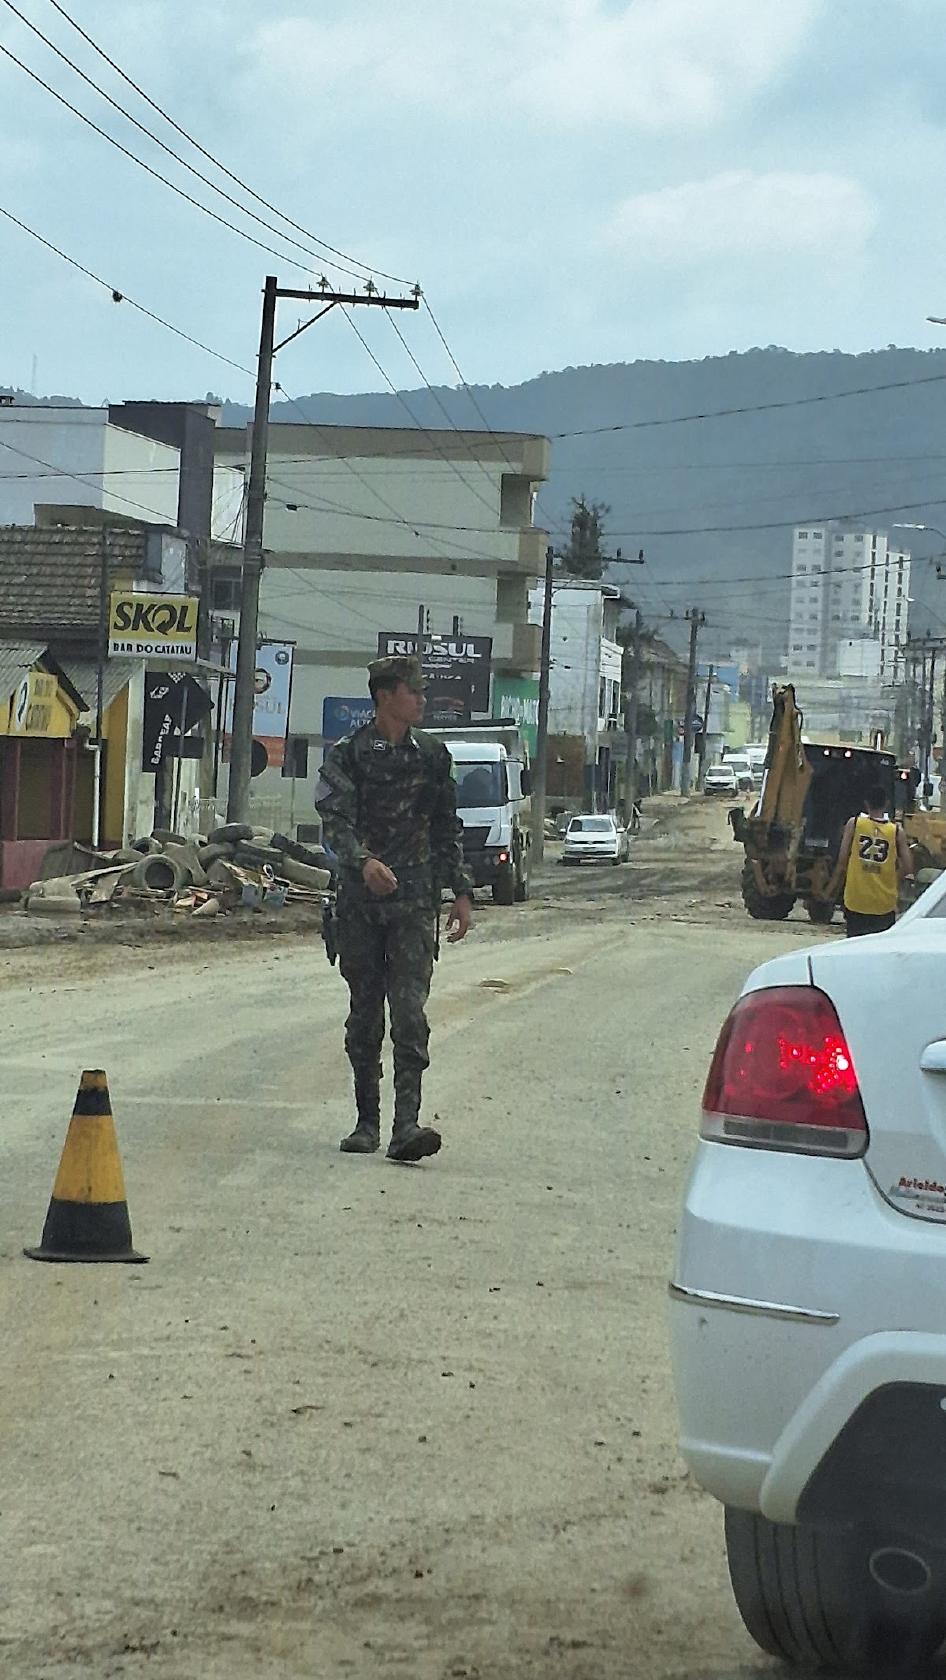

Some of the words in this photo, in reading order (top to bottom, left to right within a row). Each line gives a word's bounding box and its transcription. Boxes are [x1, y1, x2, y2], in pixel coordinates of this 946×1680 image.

[113, 601, 193, 636] SKOL
[113, 642, 133, 653] BAR
[136, 643, 153, 654] DO
[154, 644, 192, 655] CATATAU
[859, 834, 889, 863] 23
